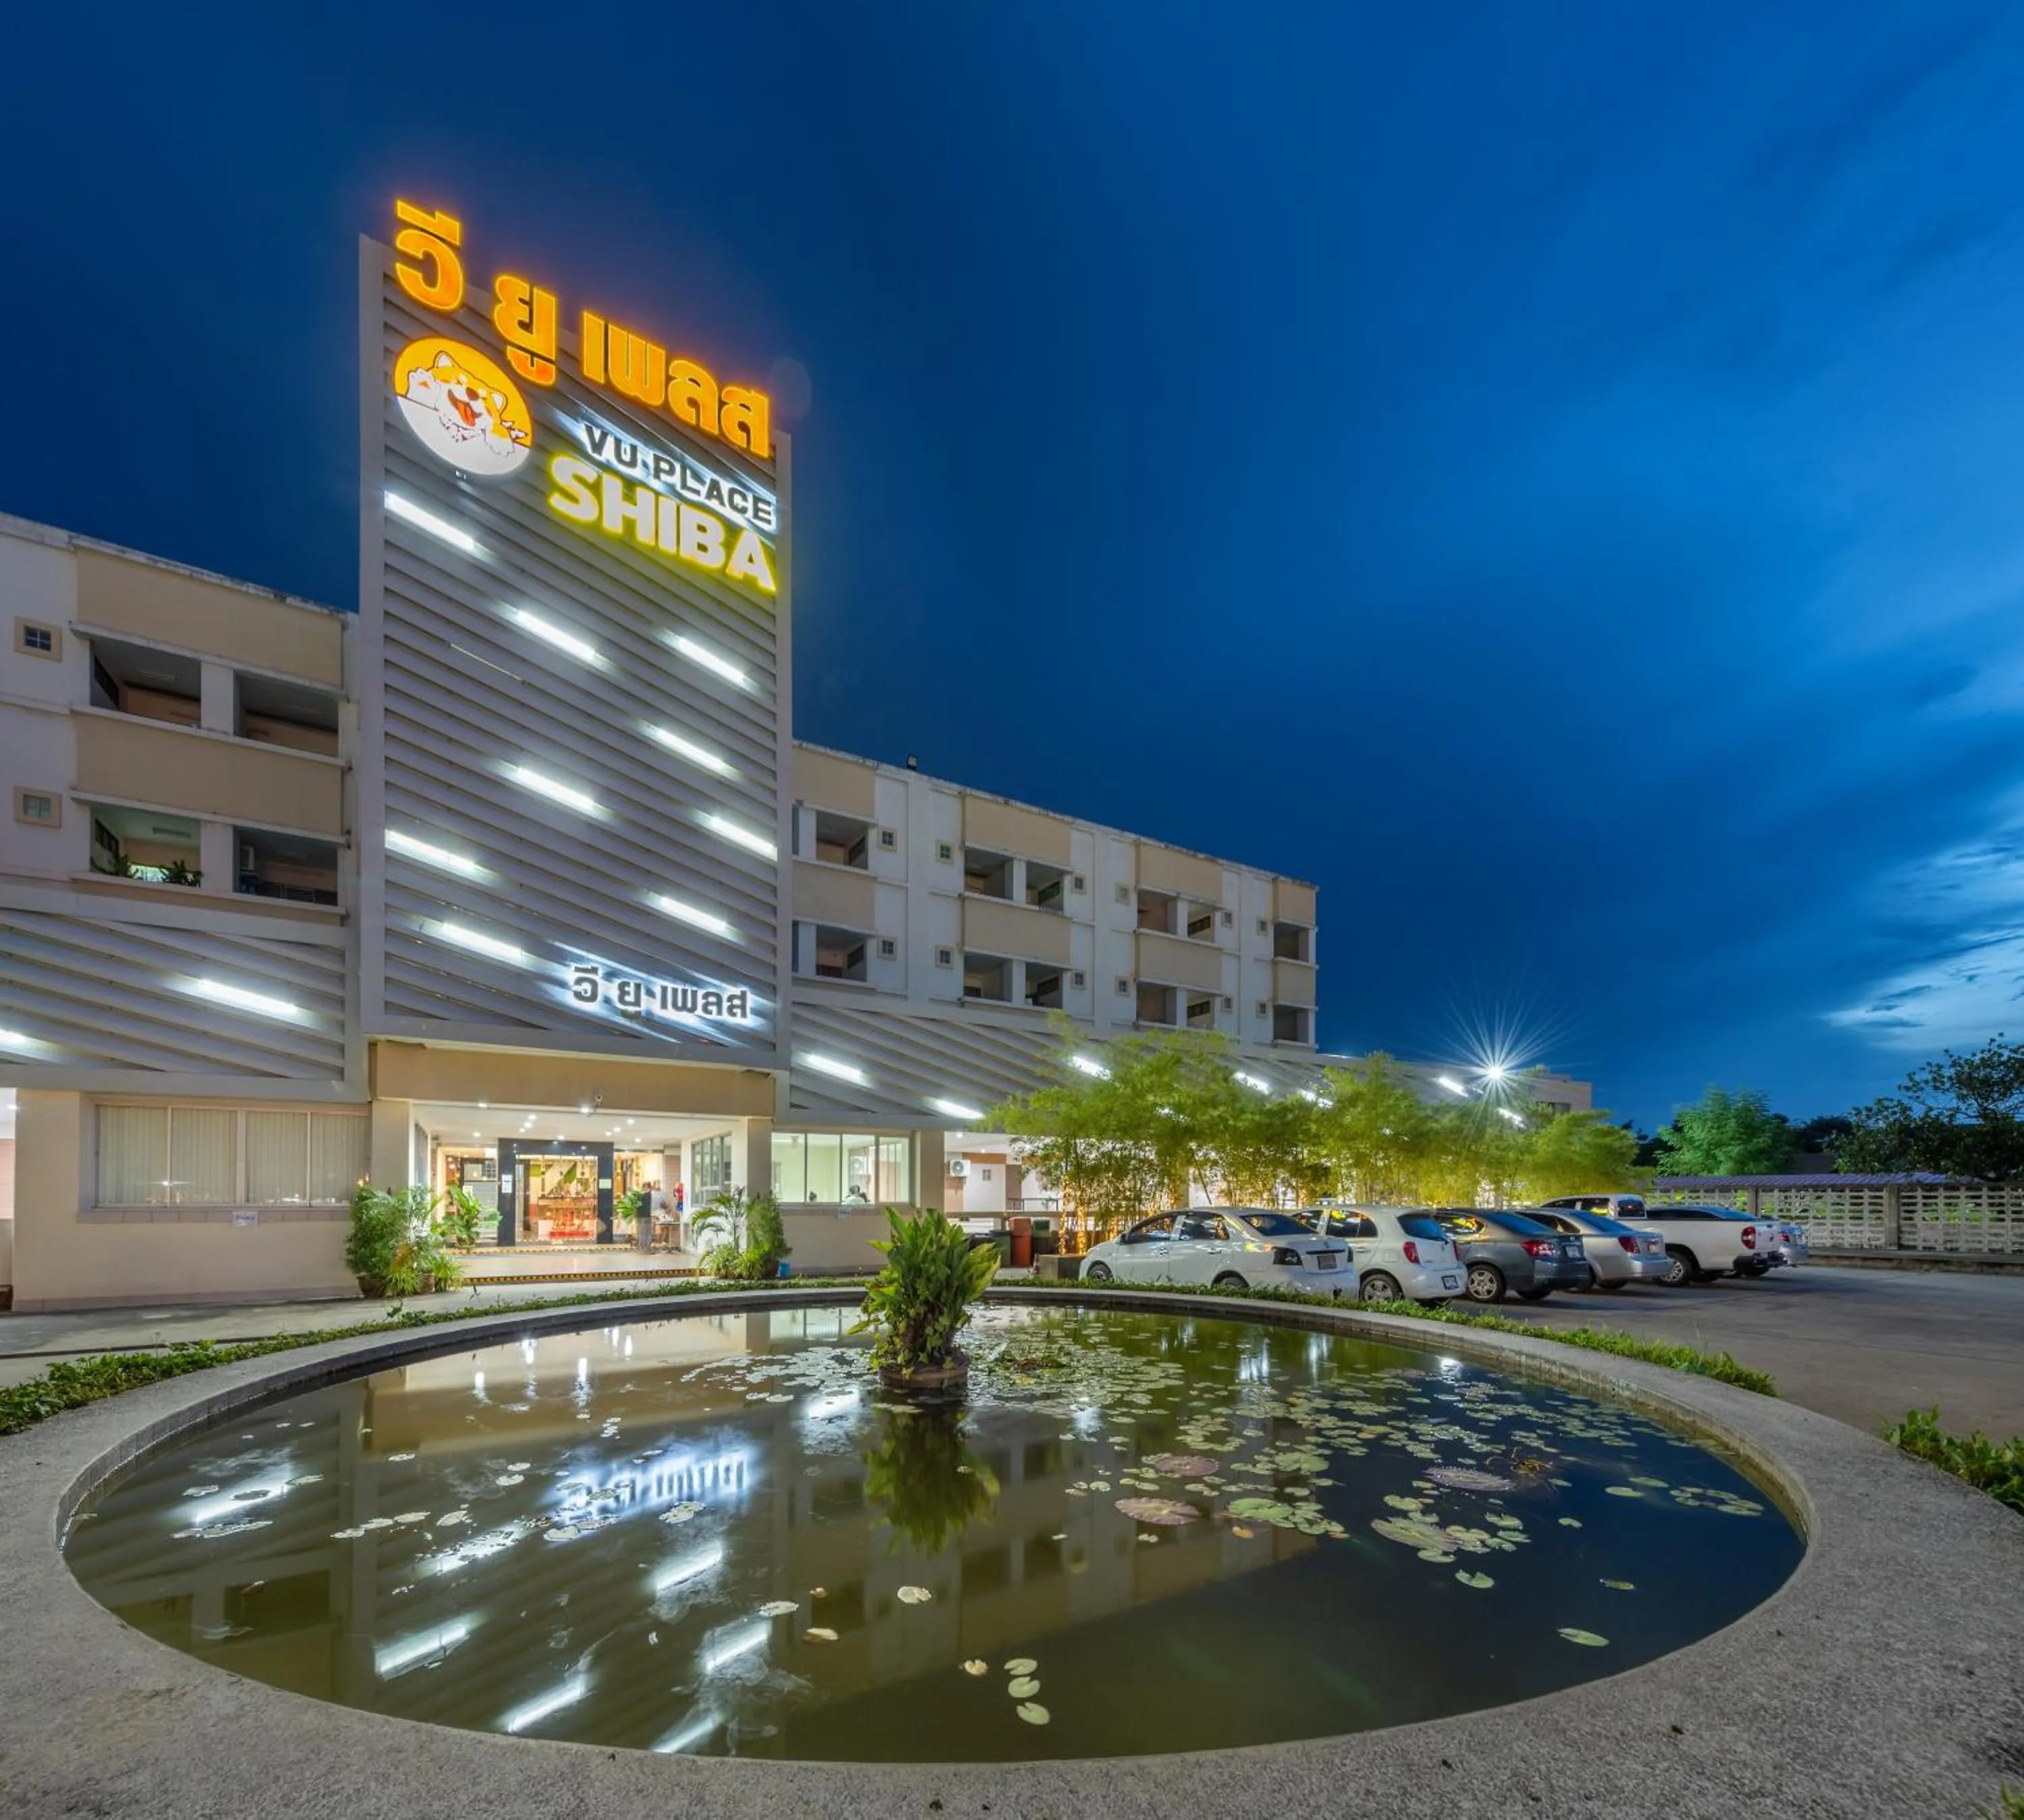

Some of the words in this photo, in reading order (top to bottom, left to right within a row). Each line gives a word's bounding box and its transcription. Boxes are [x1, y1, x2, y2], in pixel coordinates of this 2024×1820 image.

[395, 200, 463, 310] วี
[494, 275, 557, 386] ยู
[583, 311, 770, 457] เพลส
[550, 456, 776, 592] SHIBA
[584, 423, 638, 468] VU
[652, 453, 772, 525] PLACE
[573, 966, 598, 1002] วี
[617, 980, 642, 1019] ยู
[660, 986, 748, 1018] เพลส
